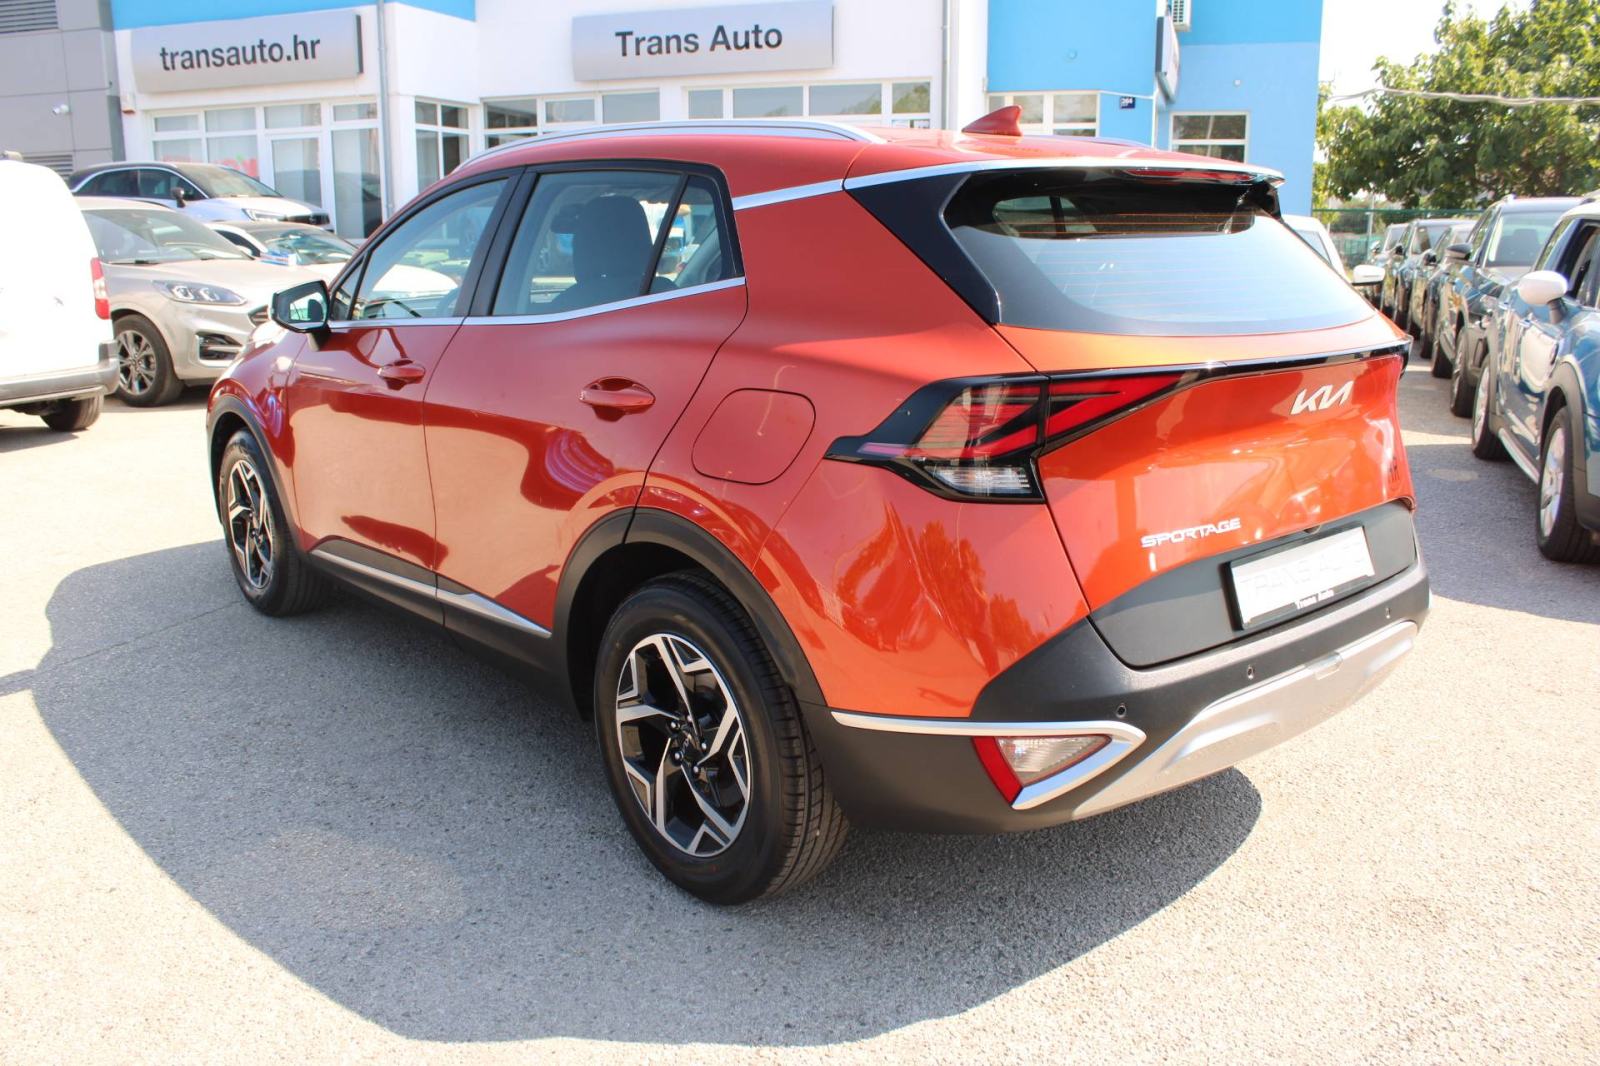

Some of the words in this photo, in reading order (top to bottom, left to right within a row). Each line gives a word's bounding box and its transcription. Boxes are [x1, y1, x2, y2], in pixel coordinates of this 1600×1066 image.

[159, 34, 321, 72] transauto.hr
[614, 31, 700, 58] Trans
[709, 23, 783, 52] Auto
[1290, 380, 1354, 415] KIA
[1141, 518, 1241, 548] SPORTAGE
